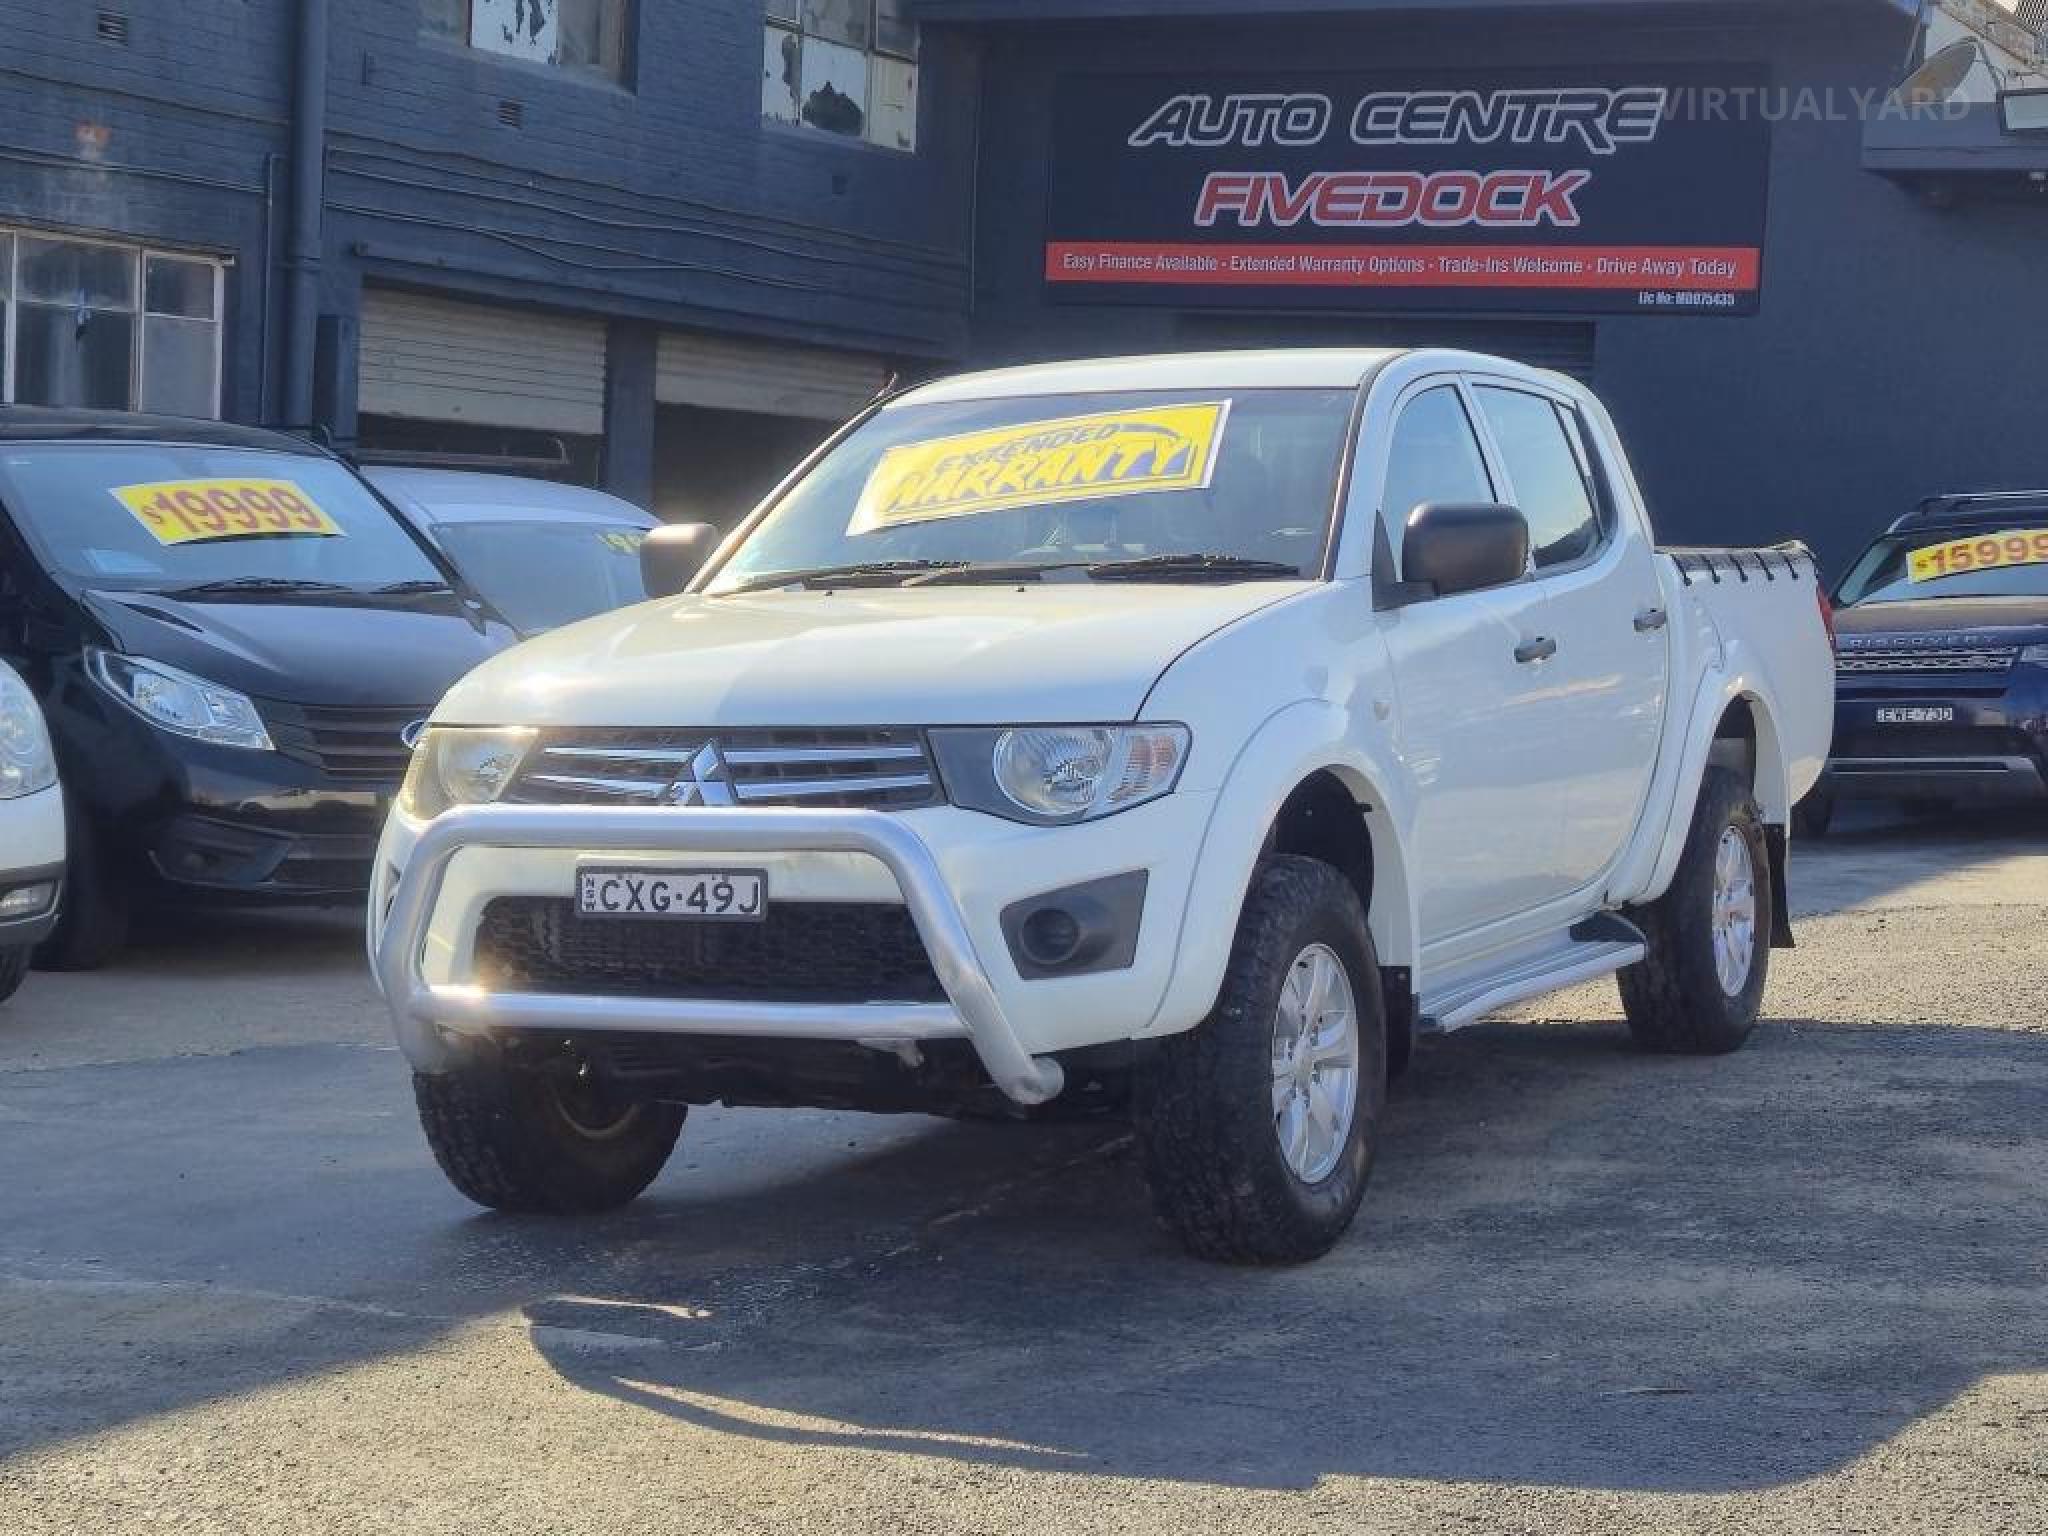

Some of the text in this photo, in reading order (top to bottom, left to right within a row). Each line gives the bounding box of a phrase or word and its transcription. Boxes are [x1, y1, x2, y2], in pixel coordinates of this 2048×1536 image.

[1127, 86, 1668, 155] AUTO CENTRE
[1193, 168, 1592, 227] FIVEDOCK
[1062, 253, 1097, 272] Easy
[1100, 253, 1152, 270] Finance
[1155, 254, 1217, 271] Available
[1230, 254, 1295, 272] Extended
[1300, 255, 1364, 276] Warranty
[1369, 255, 1426, 276] Options
[1438, 256, 1509, 273] Trade-Ins
[1513, 257, 1584, 274] Welcome
[1597, 257, 1637, 273] Drive
[1641, 257, 1685, 278] Away
[1690, 258, 1738, 279] Today
[888, 436, 1192, 510] WARRANTY
